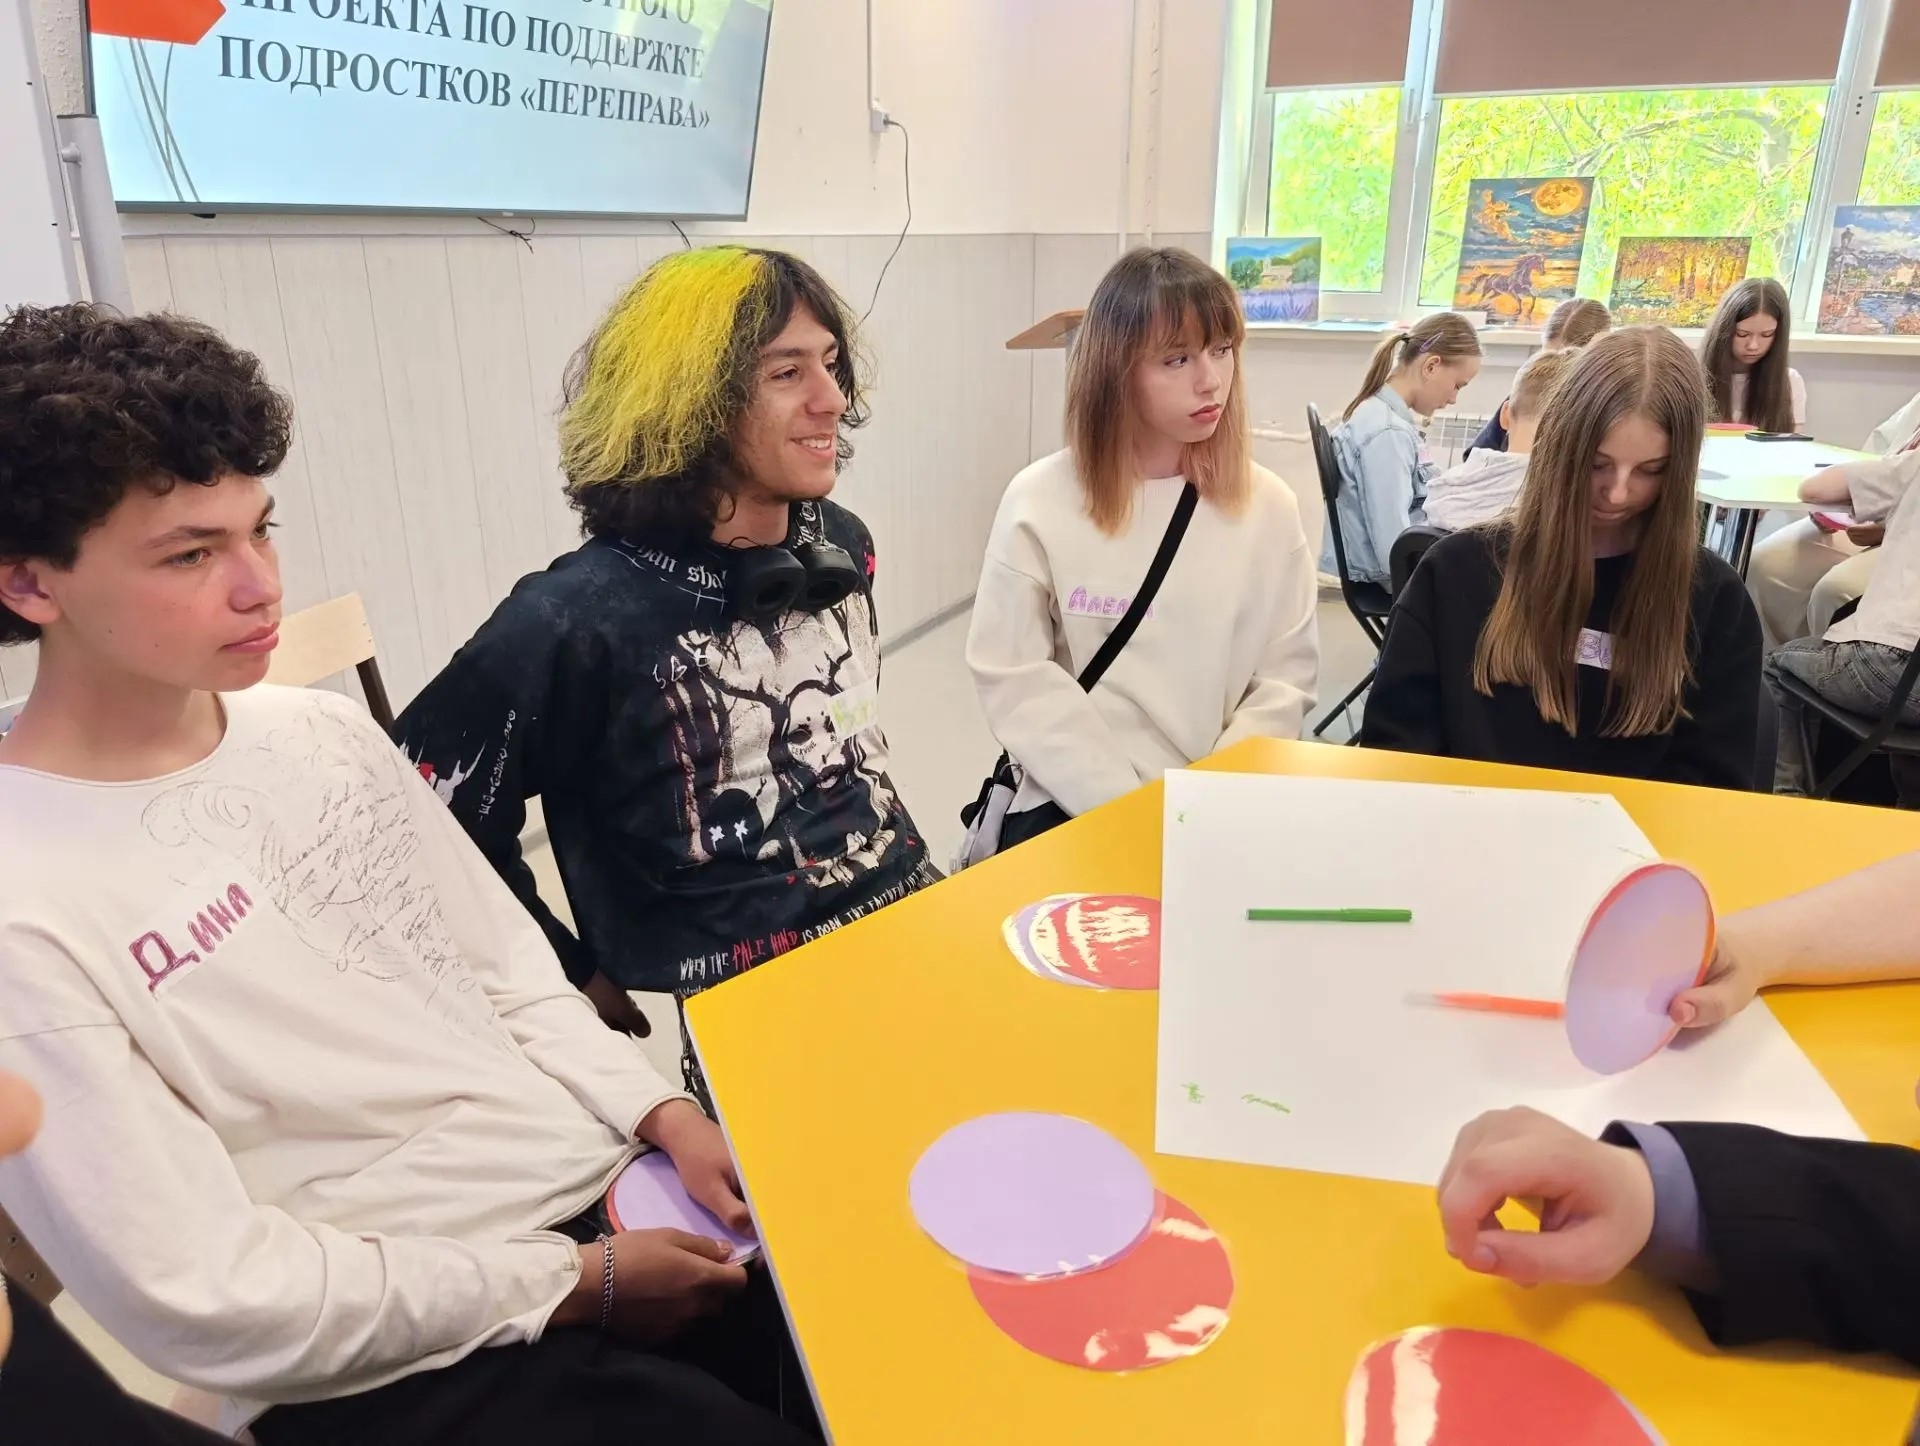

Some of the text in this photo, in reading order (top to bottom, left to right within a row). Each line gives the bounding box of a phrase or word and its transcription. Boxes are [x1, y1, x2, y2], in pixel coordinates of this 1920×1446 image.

[241, 0, 705, 79] ЕКТА ПО ПОДДЕРЖКЕ
[218, 35, 711, 129] ПОДРОСТКОВ «ПЕРЕПРАВА»
[680, 954, 706, 981] WHEN
[709, 951, 730, 977] THE
[732, 937, 767, 972] PALE
[802, 928, 814, 944] IS
[816, 913, 843, 938] BORN
